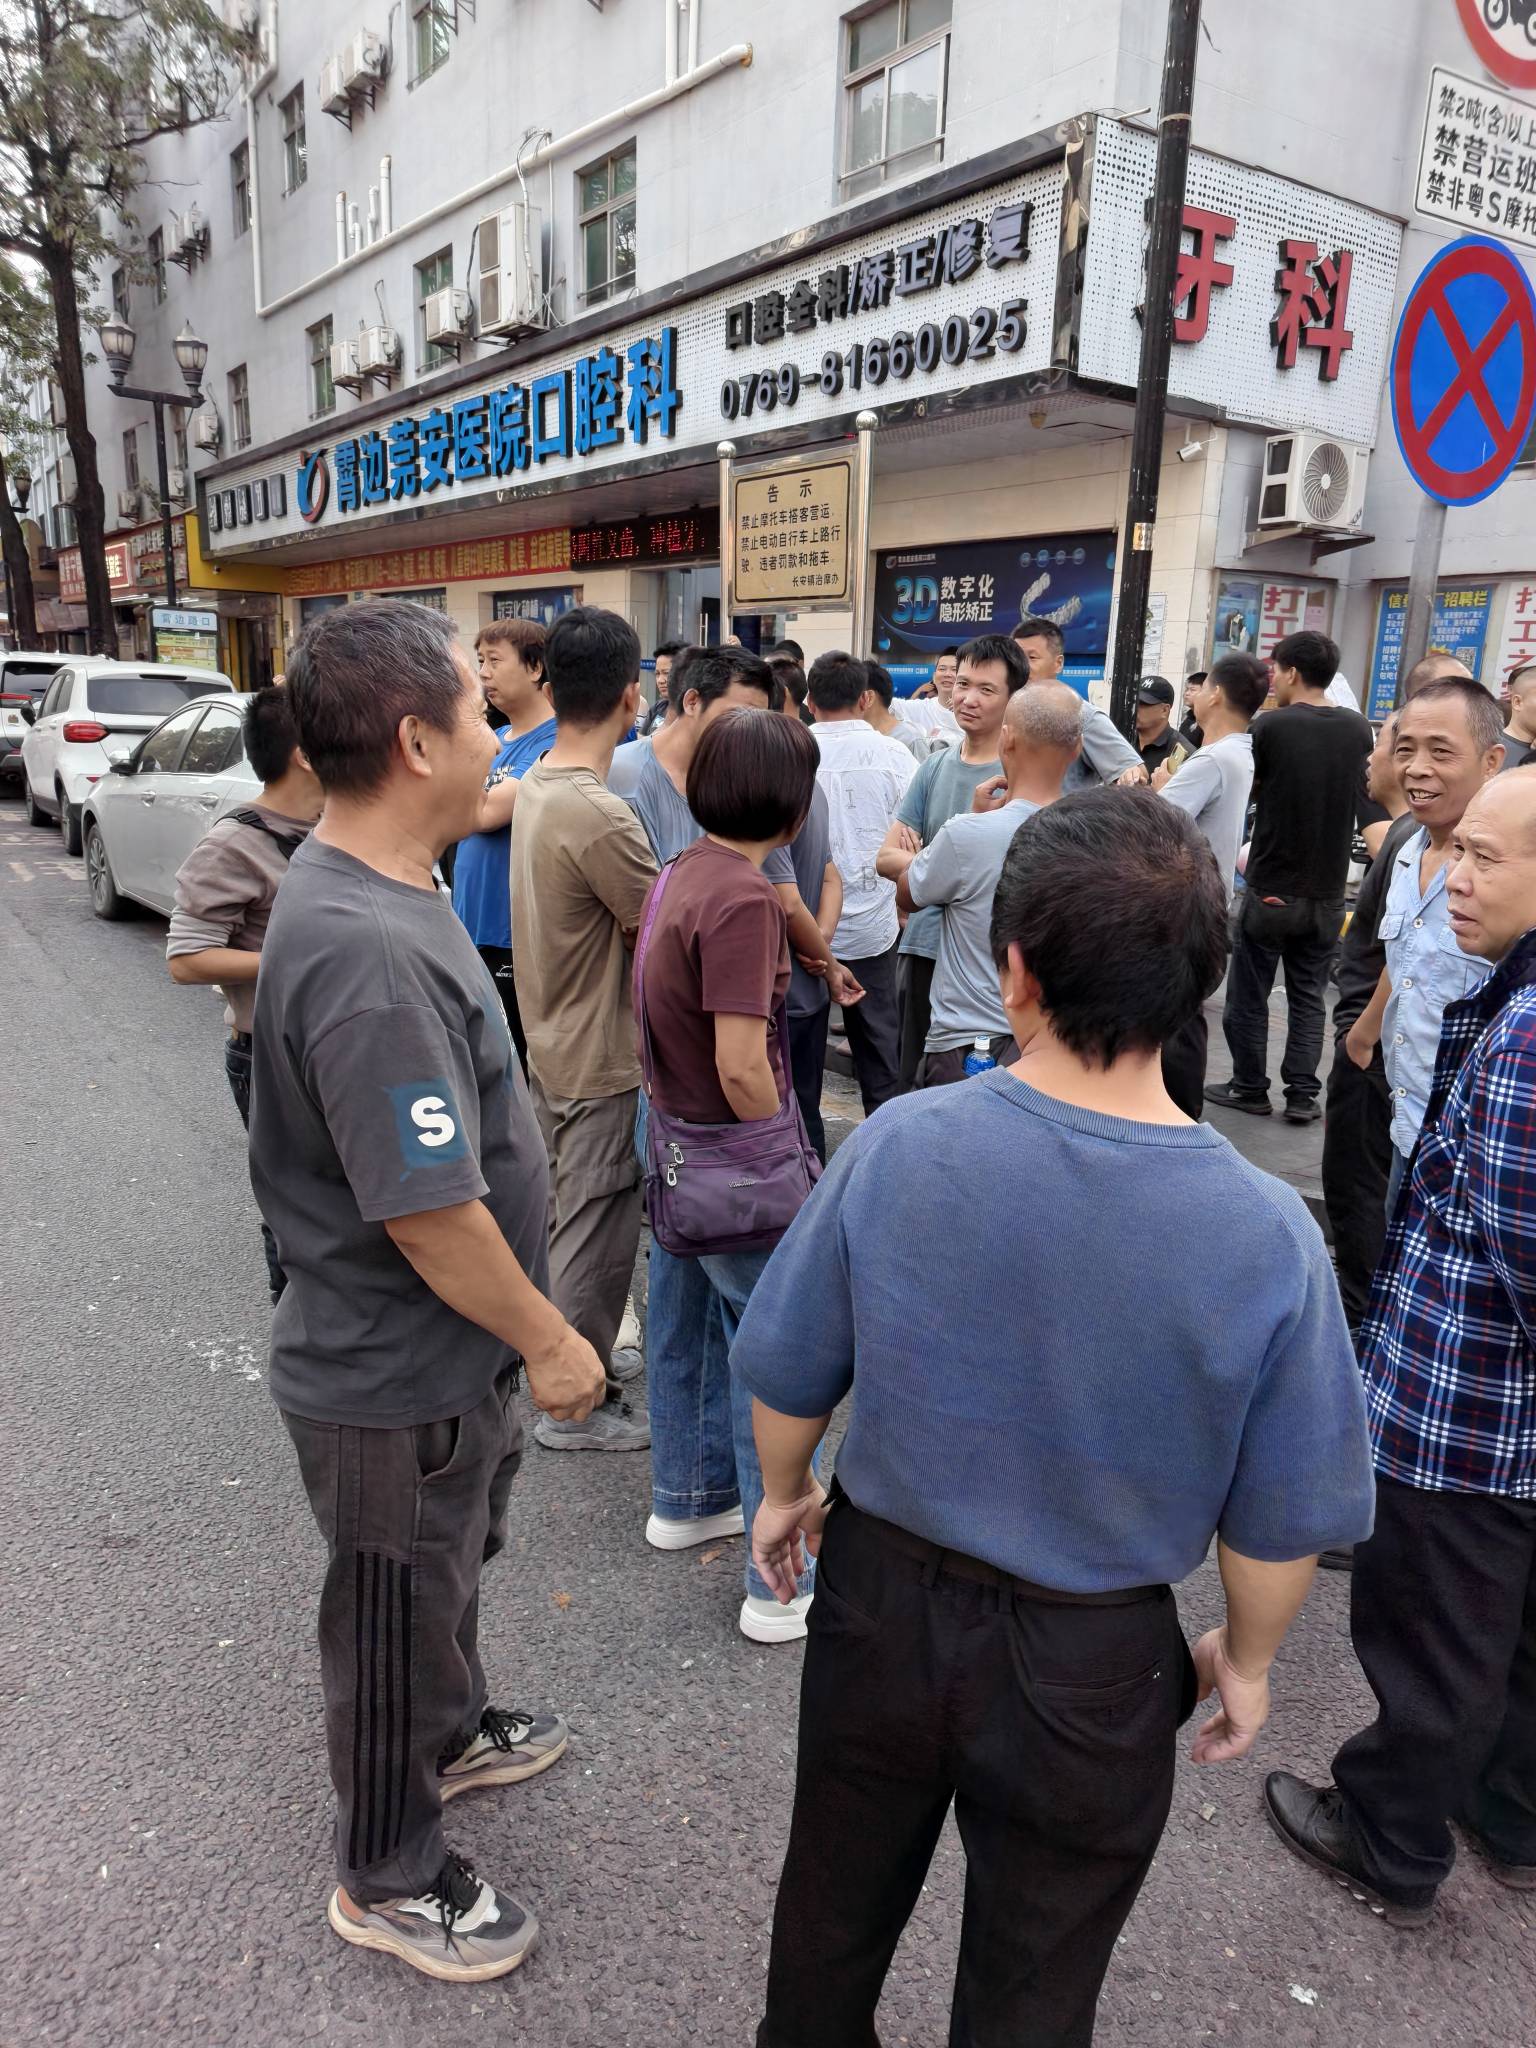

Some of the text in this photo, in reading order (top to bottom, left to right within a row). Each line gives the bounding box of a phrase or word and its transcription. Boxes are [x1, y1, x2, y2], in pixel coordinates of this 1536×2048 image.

[725, 202, 1033, 350] 口腔全科/矫正/修复
[720, 298, 1027, 420] 0769-81660025
[335, 327, 682, 513] 霄边莞安医院口腔科
[741, 525, 841, 552] 禁止电动自行车上路行
[891, 575, 938, 624] 3D
[940, 573, 994, 600] 数字化
[939, 601, 994, 623] 隐形矫正
[410, 1096, 455, 1147] S
